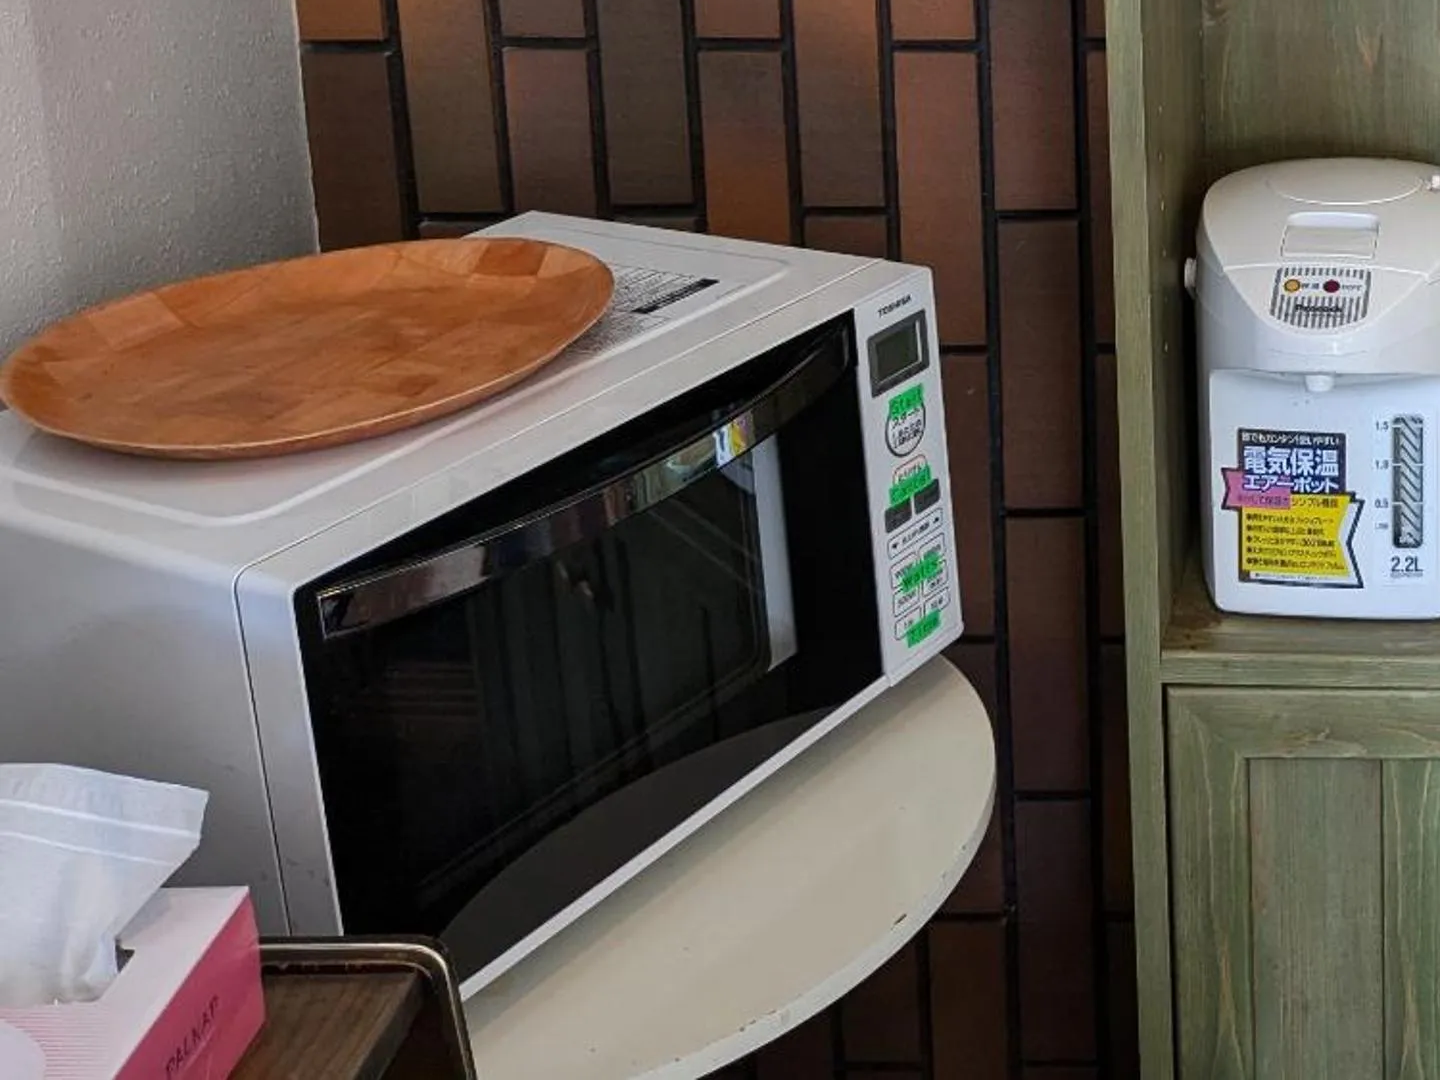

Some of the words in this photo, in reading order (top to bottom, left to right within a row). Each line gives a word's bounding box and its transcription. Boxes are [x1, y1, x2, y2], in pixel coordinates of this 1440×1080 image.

[1243, 446, 1339, 477] 電気保温
[1391, 556, 1422, 572] 2.2L
